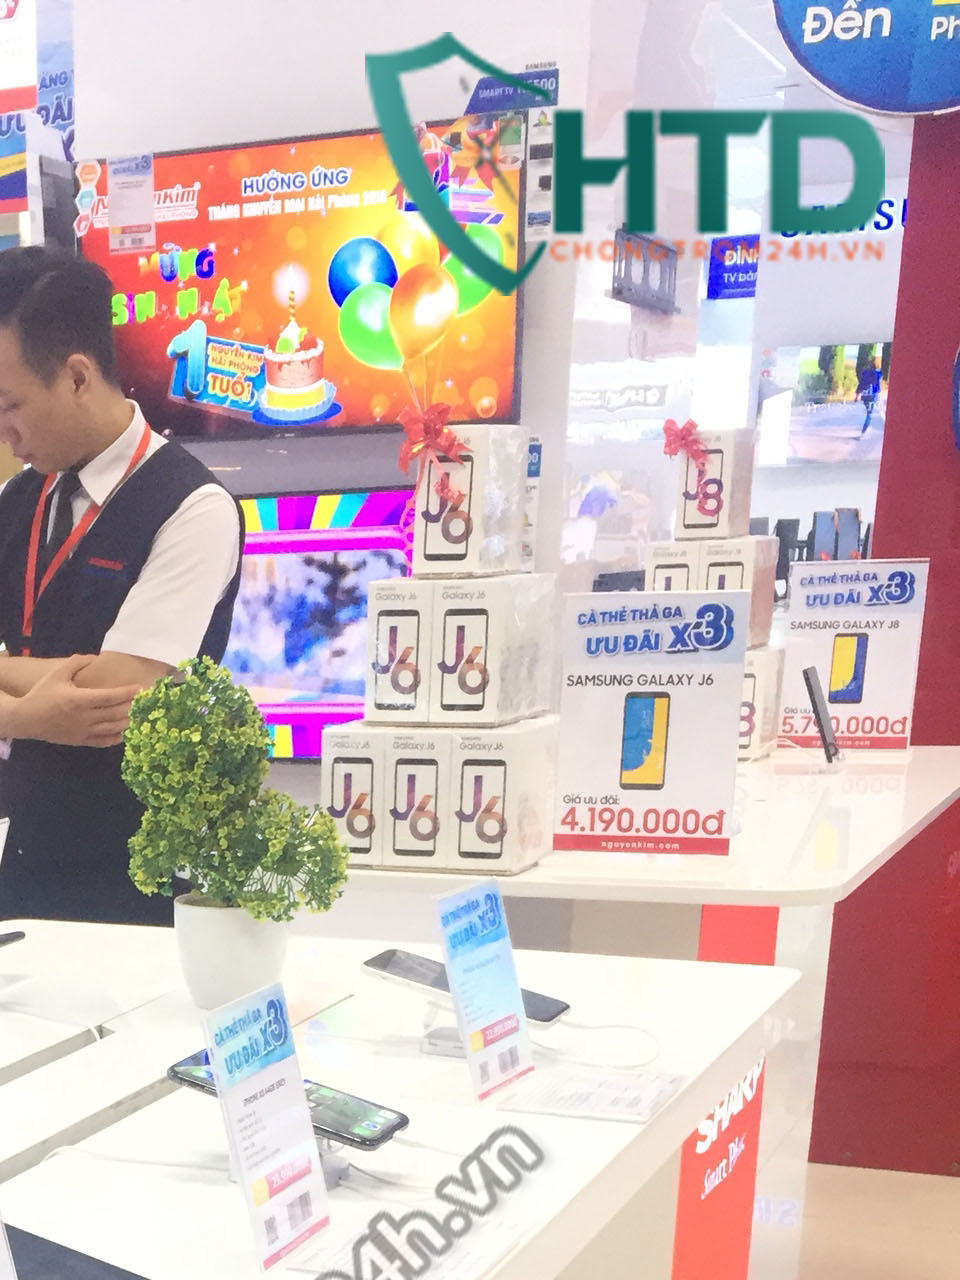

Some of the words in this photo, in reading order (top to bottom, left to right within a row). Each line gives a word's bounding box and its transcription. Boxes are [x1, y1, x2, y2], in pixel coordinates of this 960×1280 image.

[243, 169, 306, 195] HƯỞNG
[312, 165, 349, 188] ỨNG
[723, 273, 737, 284] TV
[442, 591, 474, 602] Galaxy
[577, 608, 597, 626] CÀ
[599, 606, 628, 623] THẺ
[630, 603, 659, 621] THẢ
[662, 606, 683, 620] GA
[790, 620, 841, 631] SAMSUNG
[842, 619, 885, 630] GALAXY
[888, 619, 901, 629] J8
[586, 635, 619, 656] ƯU
[622, 628, 661, 653] ĐÃI
[370, 625, 422, 696] J6
[436, 624, 490, 696] J6
[566, 674, 634, 687] SAMSUNG
[636, 673, 695, 687] GALAXY
[697, 673, 714, 686] J6
[459, 742, 492, 752] Galaxy
[326, 772, 376, 840] J6
[389, 773, 440, 842] J6
[454, 775, 508, 844] J6
[562, 793, 582, 805] Giá
[583, 796, 598, 805] ưu
[559, 806, 727, 836] 4.190.000đ
[601, 840, 680, 850] nguyenkim.com
